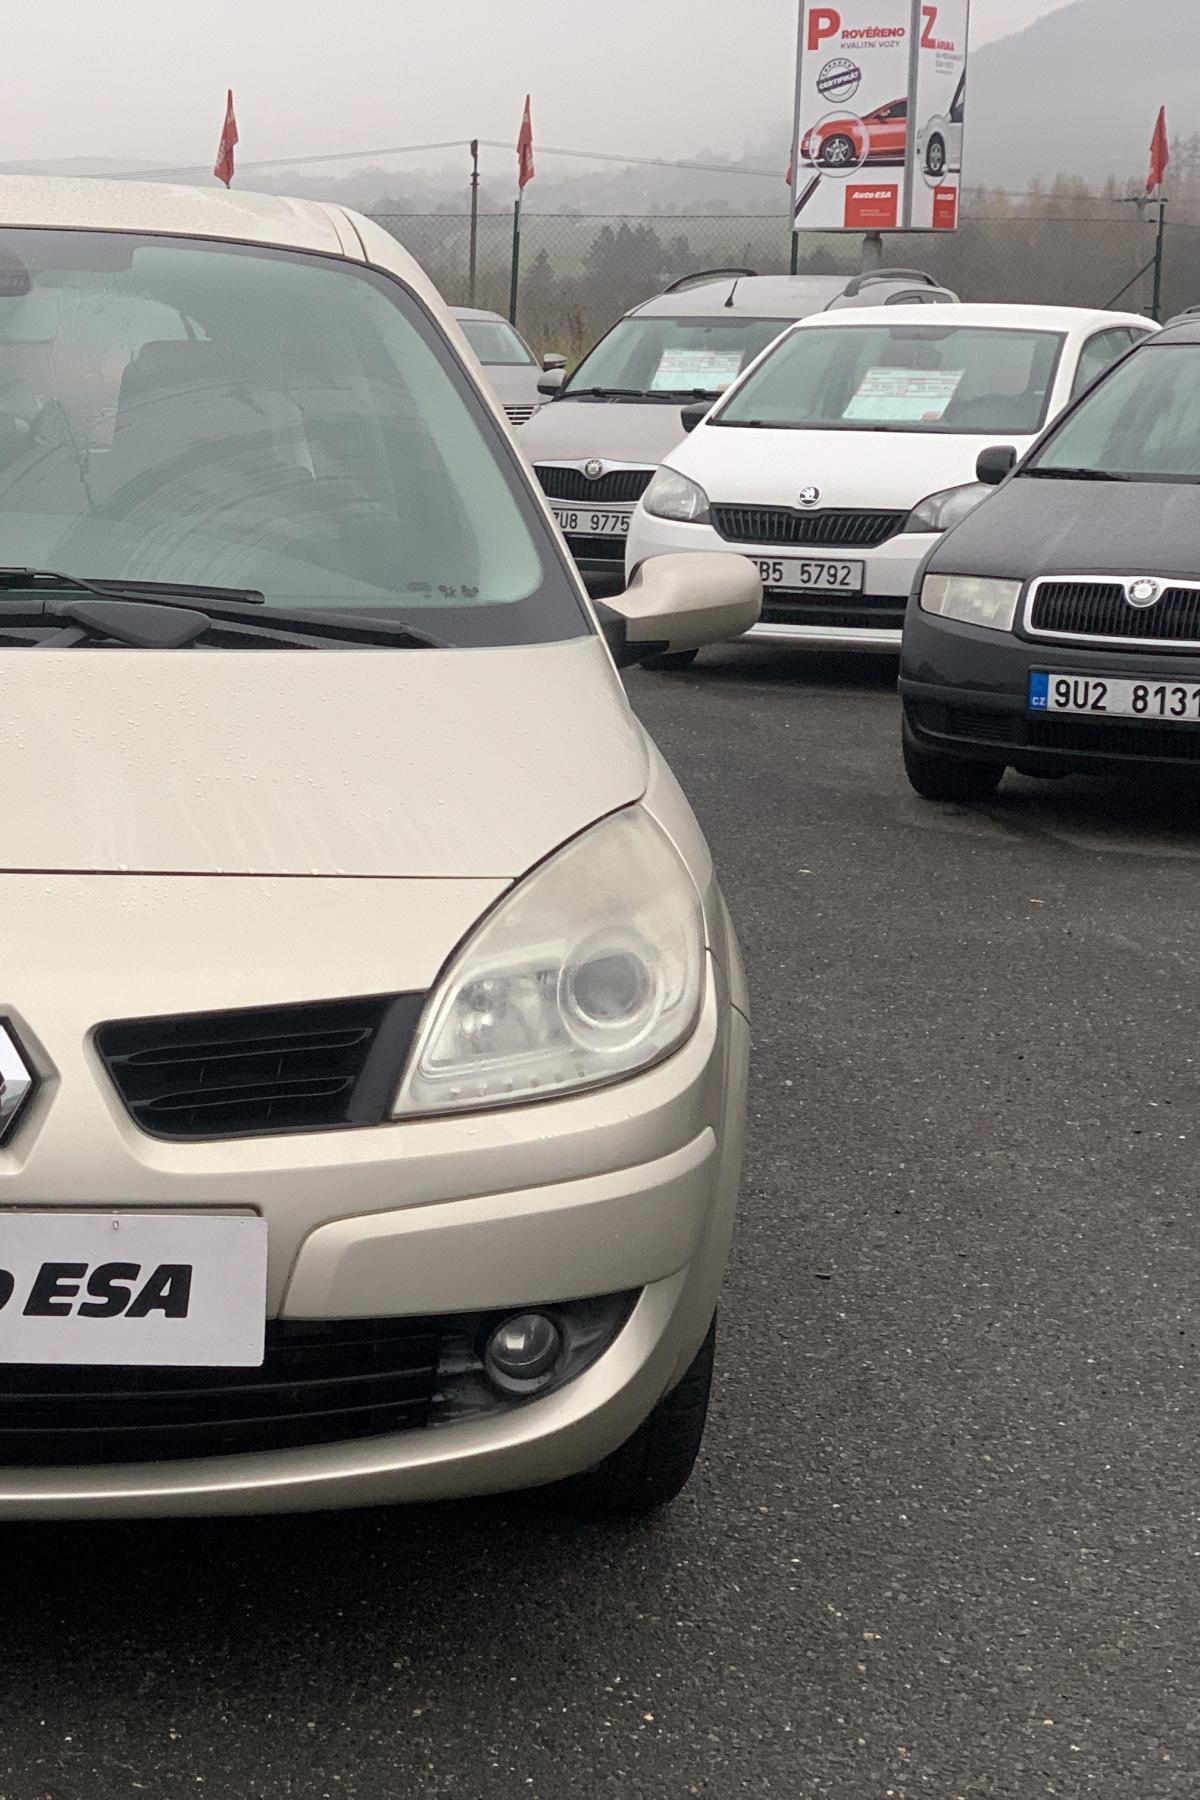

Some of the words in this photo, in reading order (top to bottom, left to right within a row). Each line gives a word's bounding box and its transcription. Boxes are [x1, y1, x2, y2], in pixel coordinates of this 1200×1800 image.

[878, 40, 900, 48] VOZY
[851, 191, 874, 199] Auto
[875, 191, 892, 199] ESA
[590, 514, 631, 533] 9775
[752, 560, 783, 583] B5
[800, 562, 852, 586] 5792
[1032, 696, 1046, 707] CZ
[1054, 679, 1108, 712] 9U2
[23, 1261, 193, 1318] ESA
